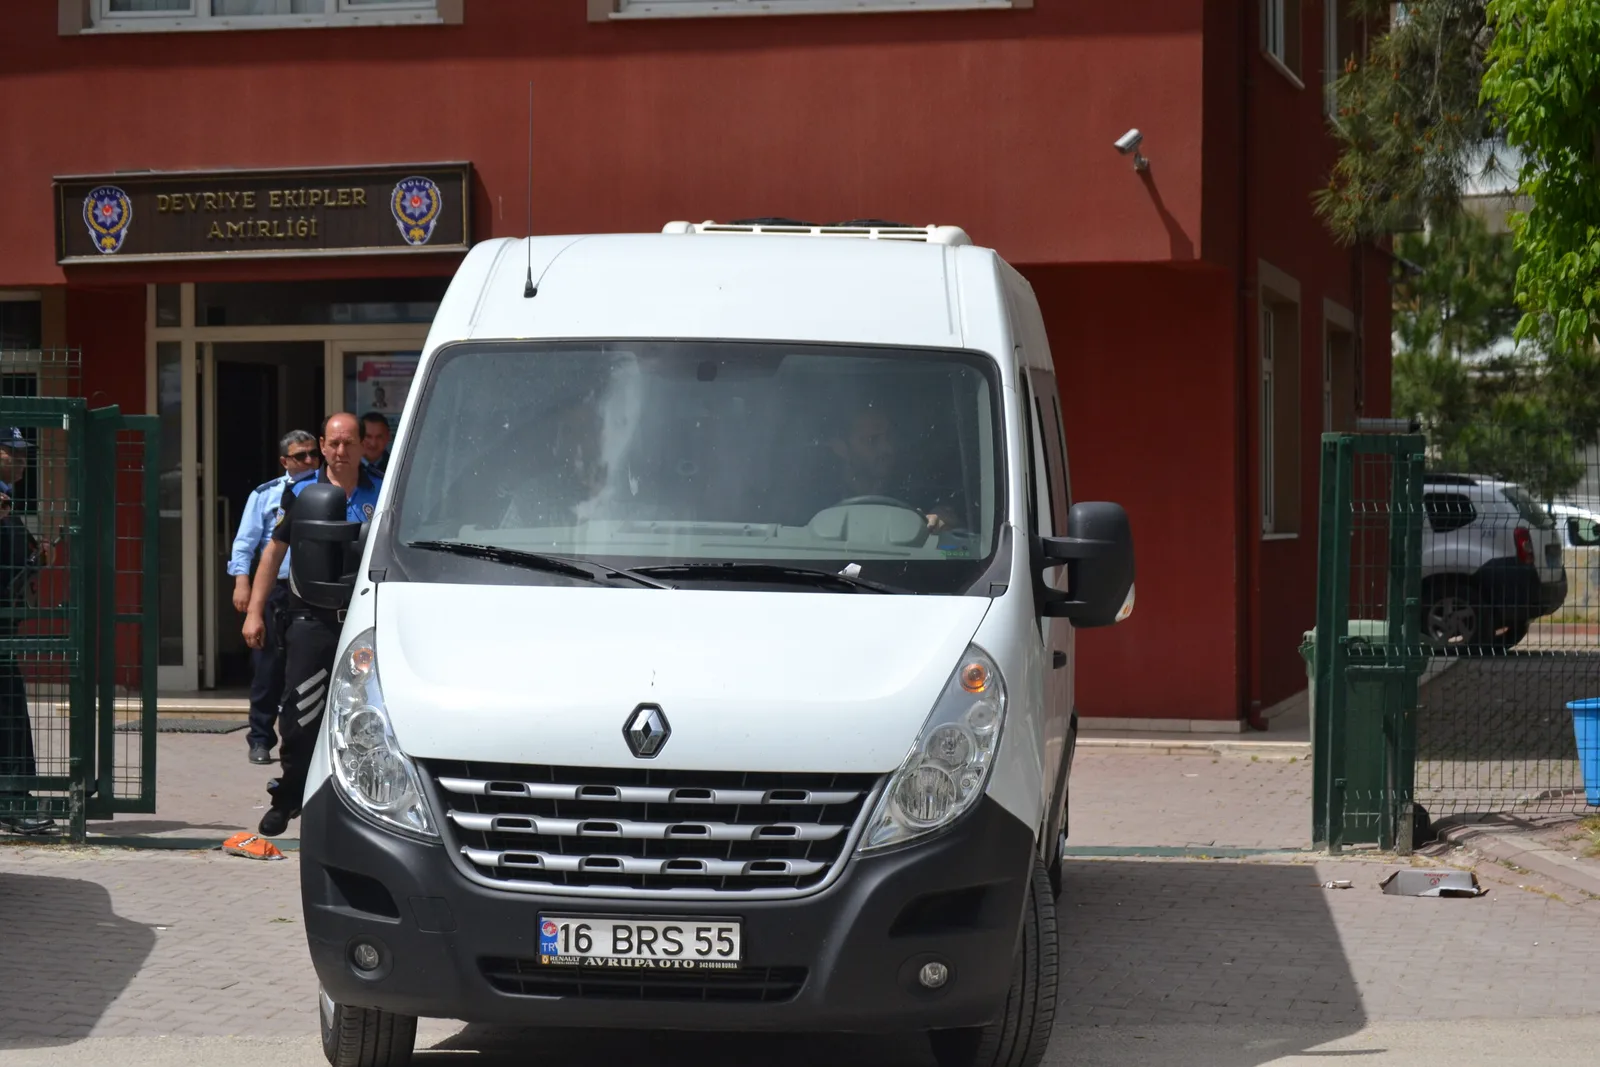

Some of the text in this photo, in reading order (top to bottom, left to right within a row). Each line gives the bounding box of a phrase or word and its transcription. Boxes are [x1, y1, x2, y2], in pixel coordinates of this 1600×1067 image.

[560, 923, 735, 957] 16 BRS 55
[541, 942, 556, 953] TR
[584, 957, 695, 968] AVRUPA OTO
